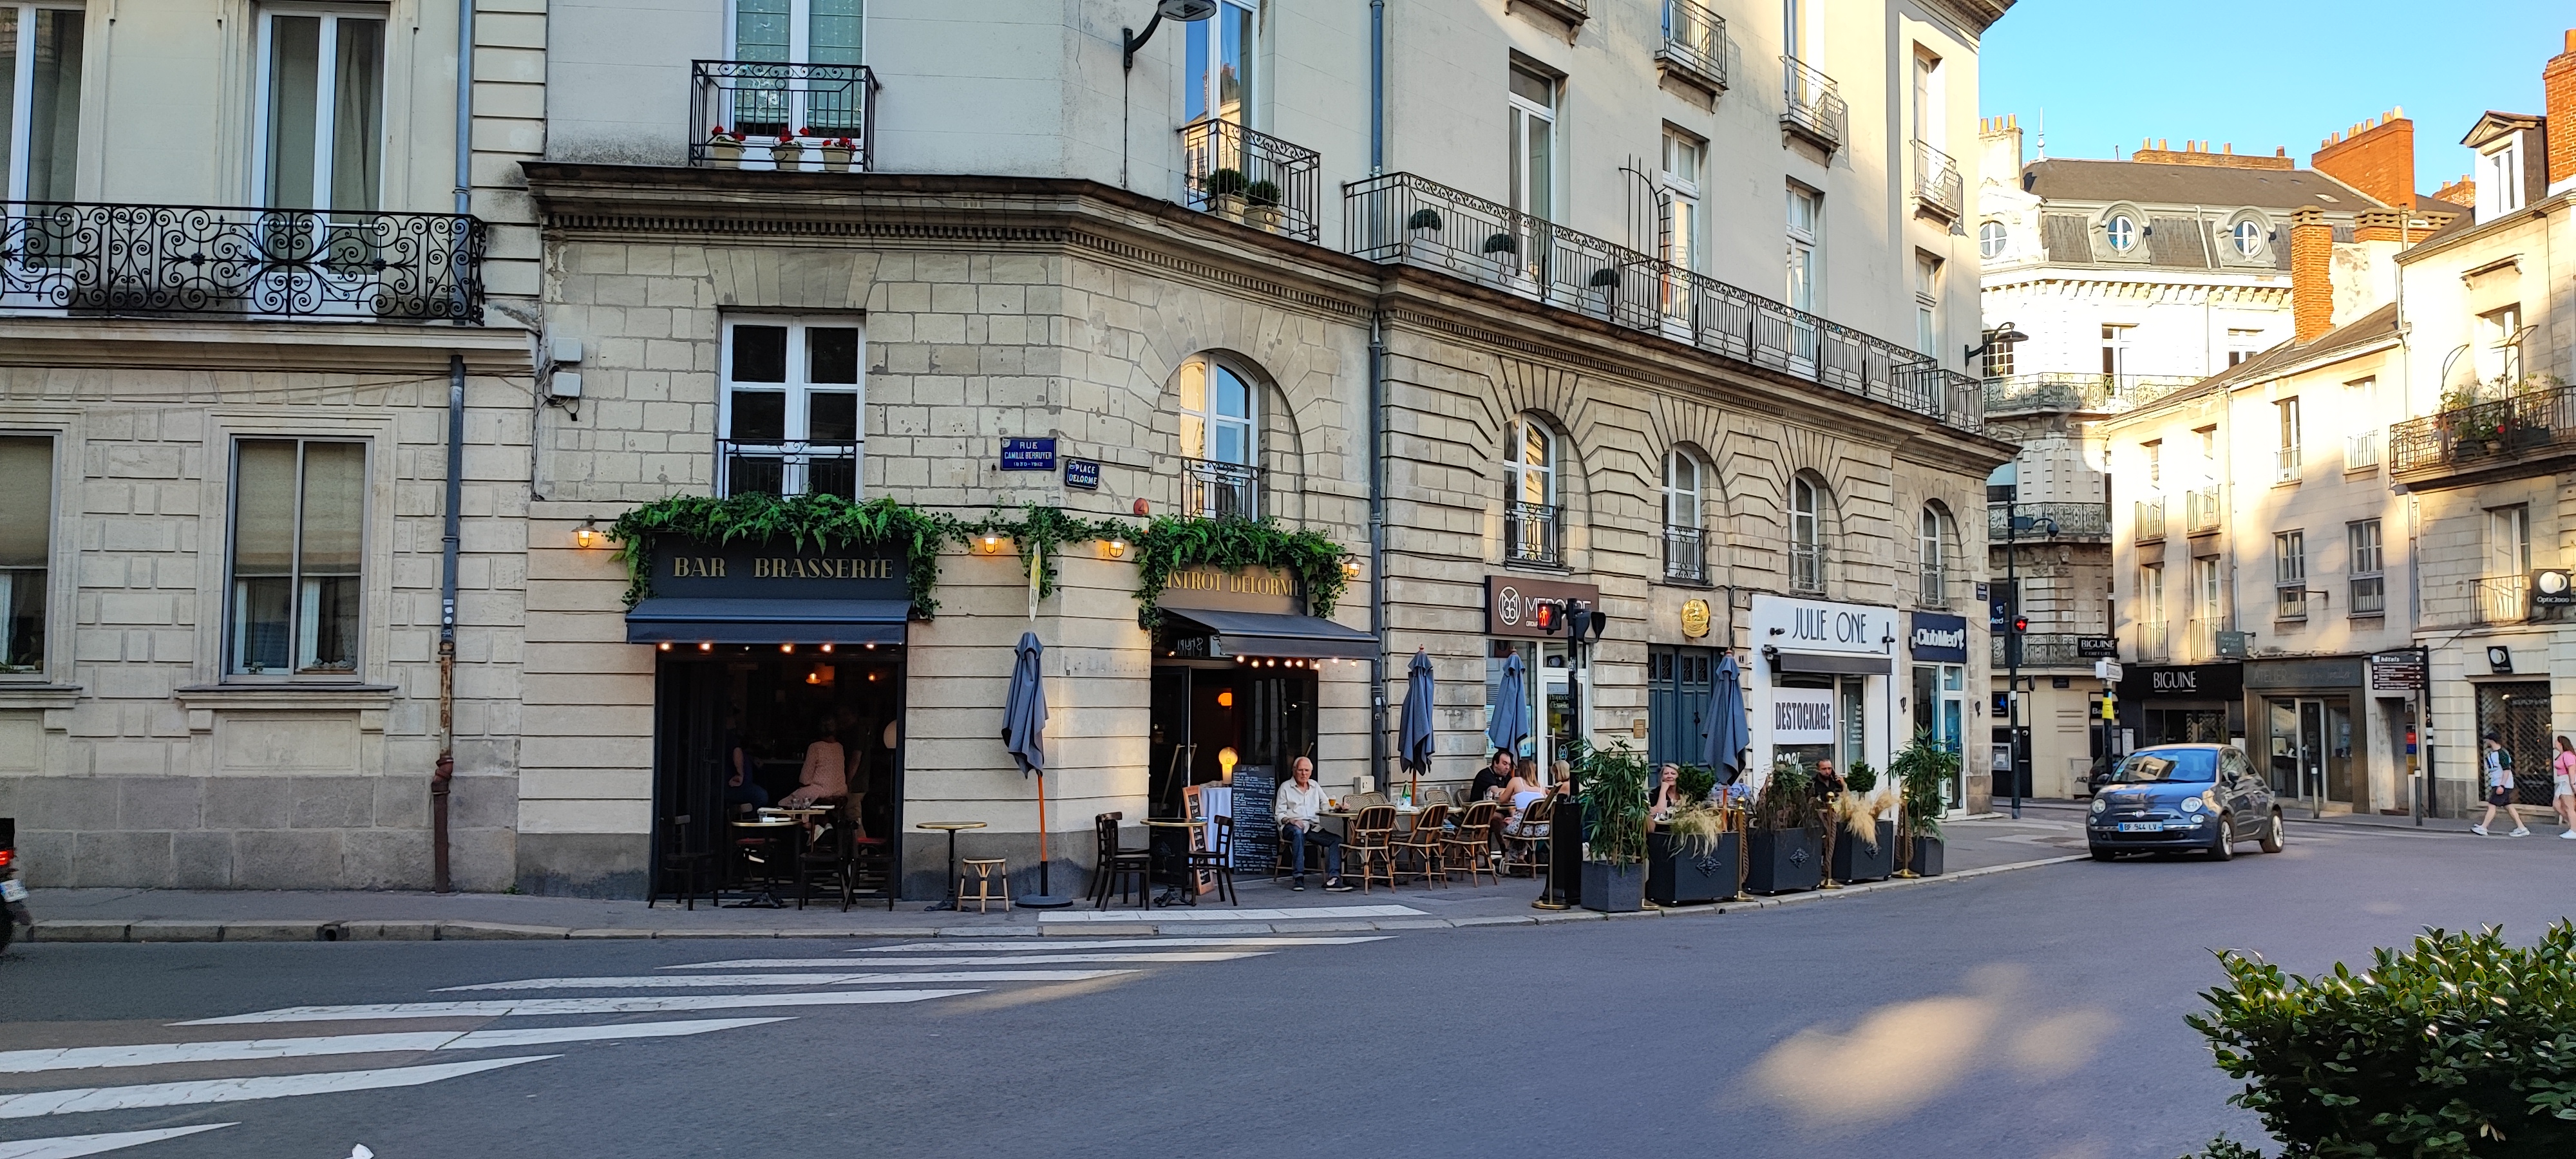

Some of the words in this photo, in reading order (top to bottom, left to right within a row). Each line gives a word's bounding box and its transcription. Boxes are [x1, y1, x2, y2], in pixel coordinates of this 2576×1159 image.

[1019, 441, 1038, 449] RUE
[1004, 451, 1025, 460] CAMILLE
[1075, 464, 1096, 475] PLACE
[1068, 473, 1097, 485] DELORME
[673, 557, 726, 578] BAR
[753, 558, 893, 579] BRASSERIE
[1166, 570, 1223, 592] ISTROT
[1229, 574, 1303, 597] DELORME
[1792, 607, 1827, 641] JULIE
[1836, 612, 1867, 644] ONE
[2081, 639, 2115, 648] BIGUINE
[2153, 671, 2197, 689] BIGUINE
[1776, 702, 1830, 731] DESTOCKAGE
